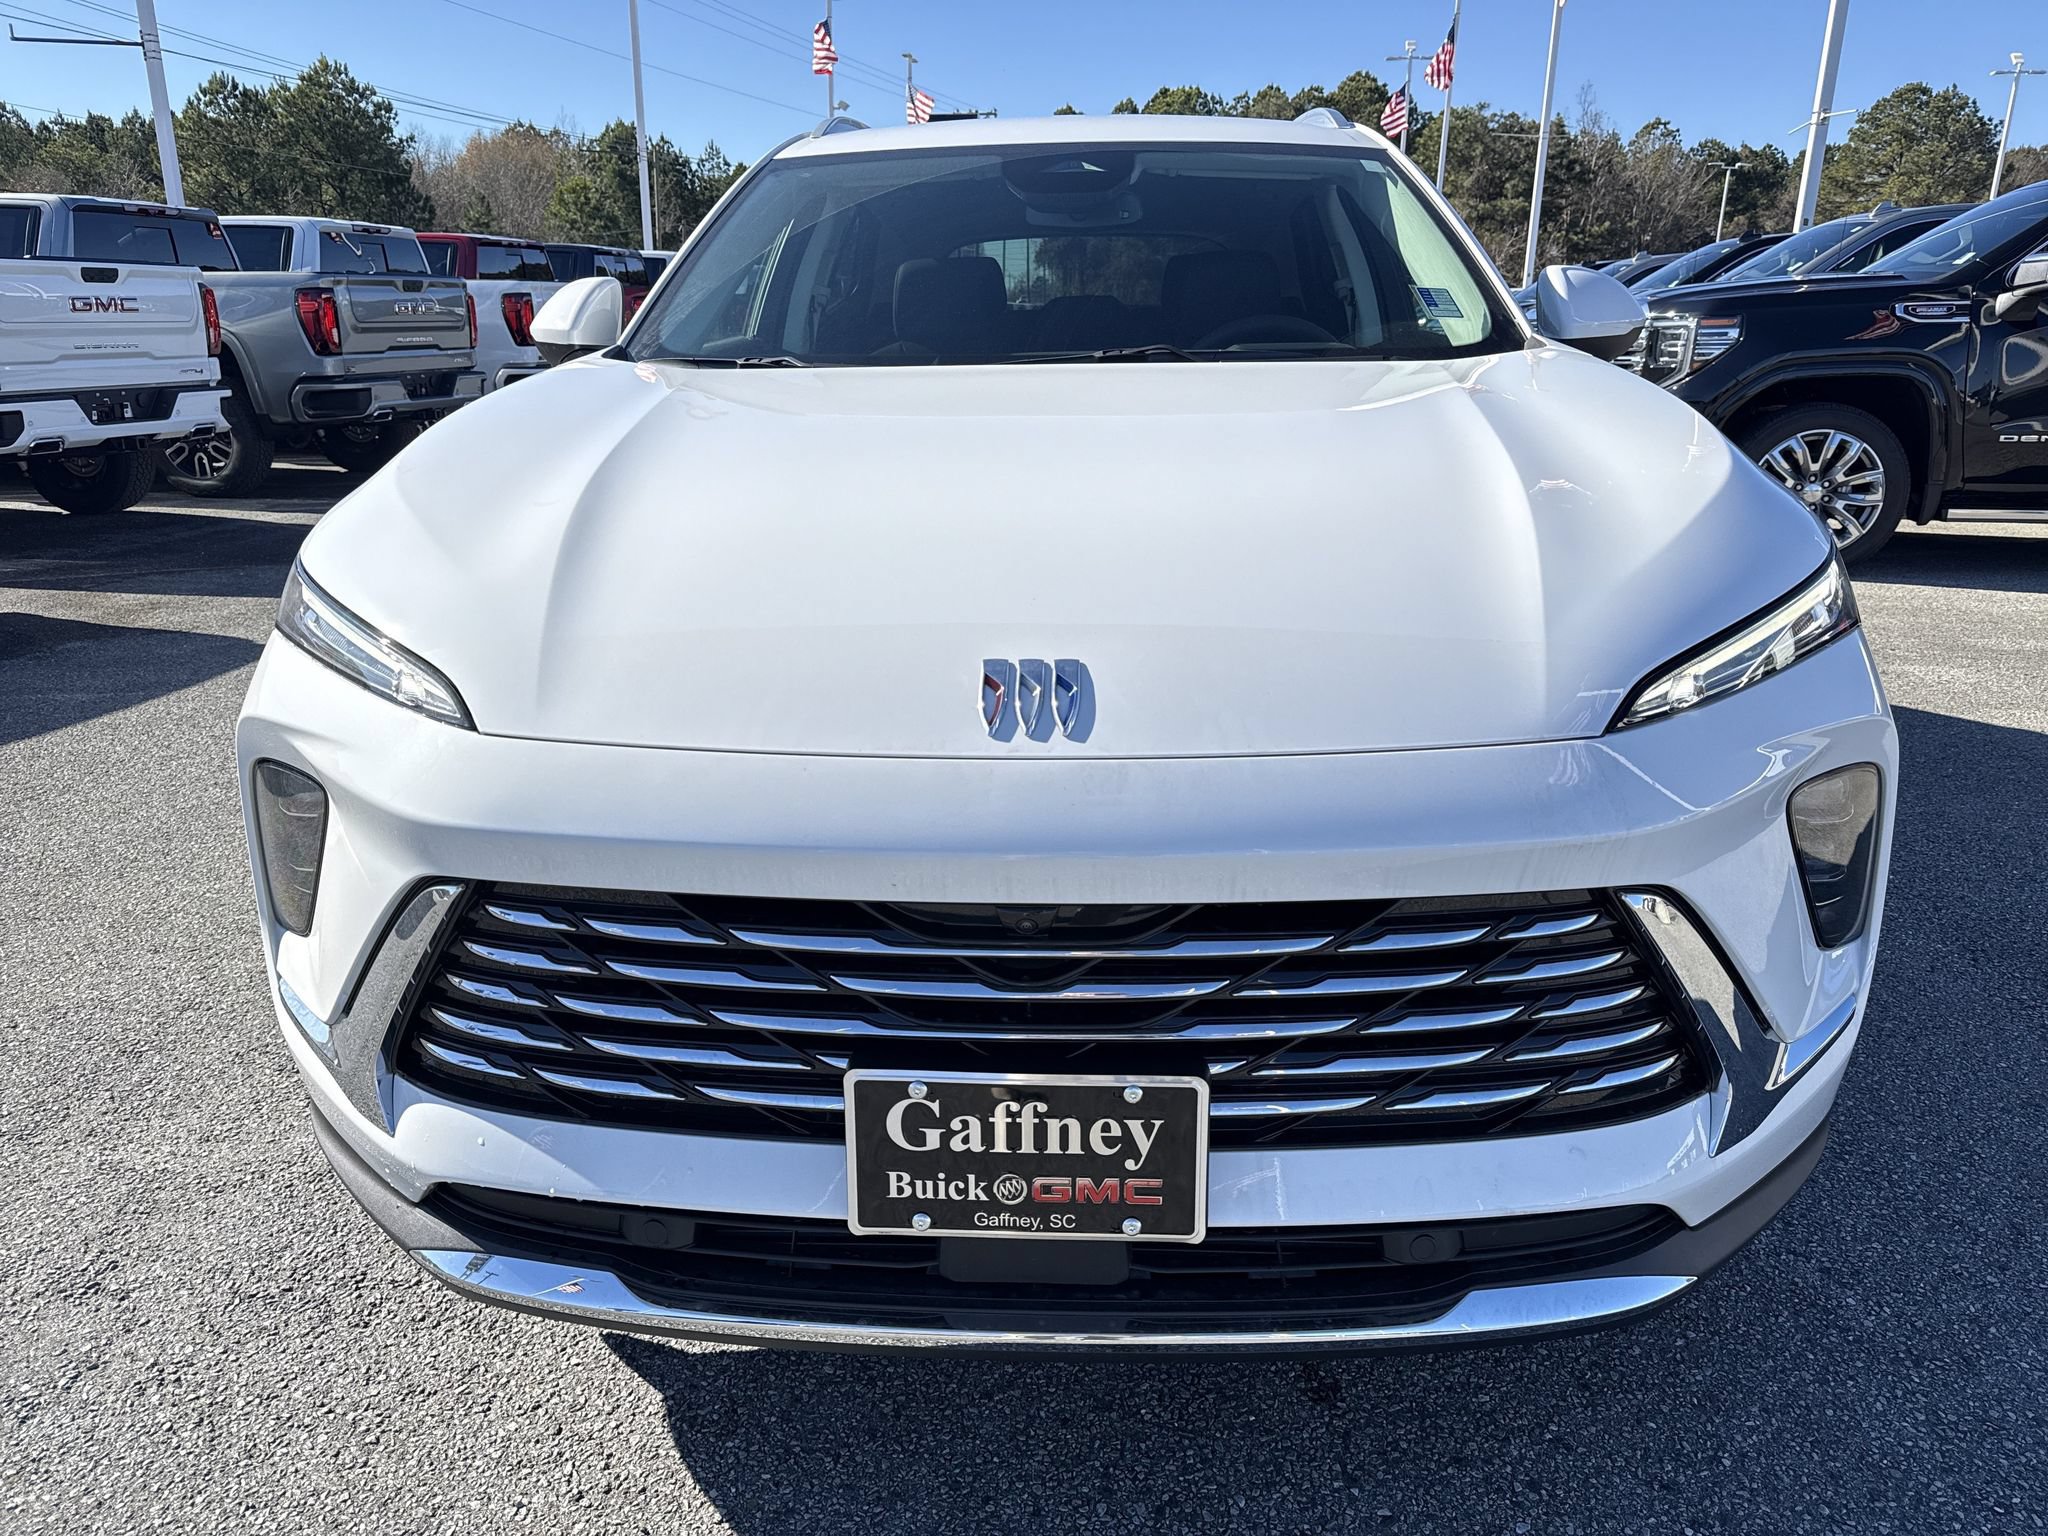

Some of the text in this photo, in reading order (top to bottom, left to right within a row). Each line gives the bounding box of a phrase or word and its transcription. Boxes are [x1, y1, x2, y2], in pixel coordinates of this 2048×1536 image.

[69, 296, 139, 313] GMC
[394, 302, 436, 315] GMC
[885, 1098, 1166, 1171] Gaffney
[885, 1171, 1163, 1206] Buick GMC
[974, 1211, 1077, 1231] Gaffney, SC
